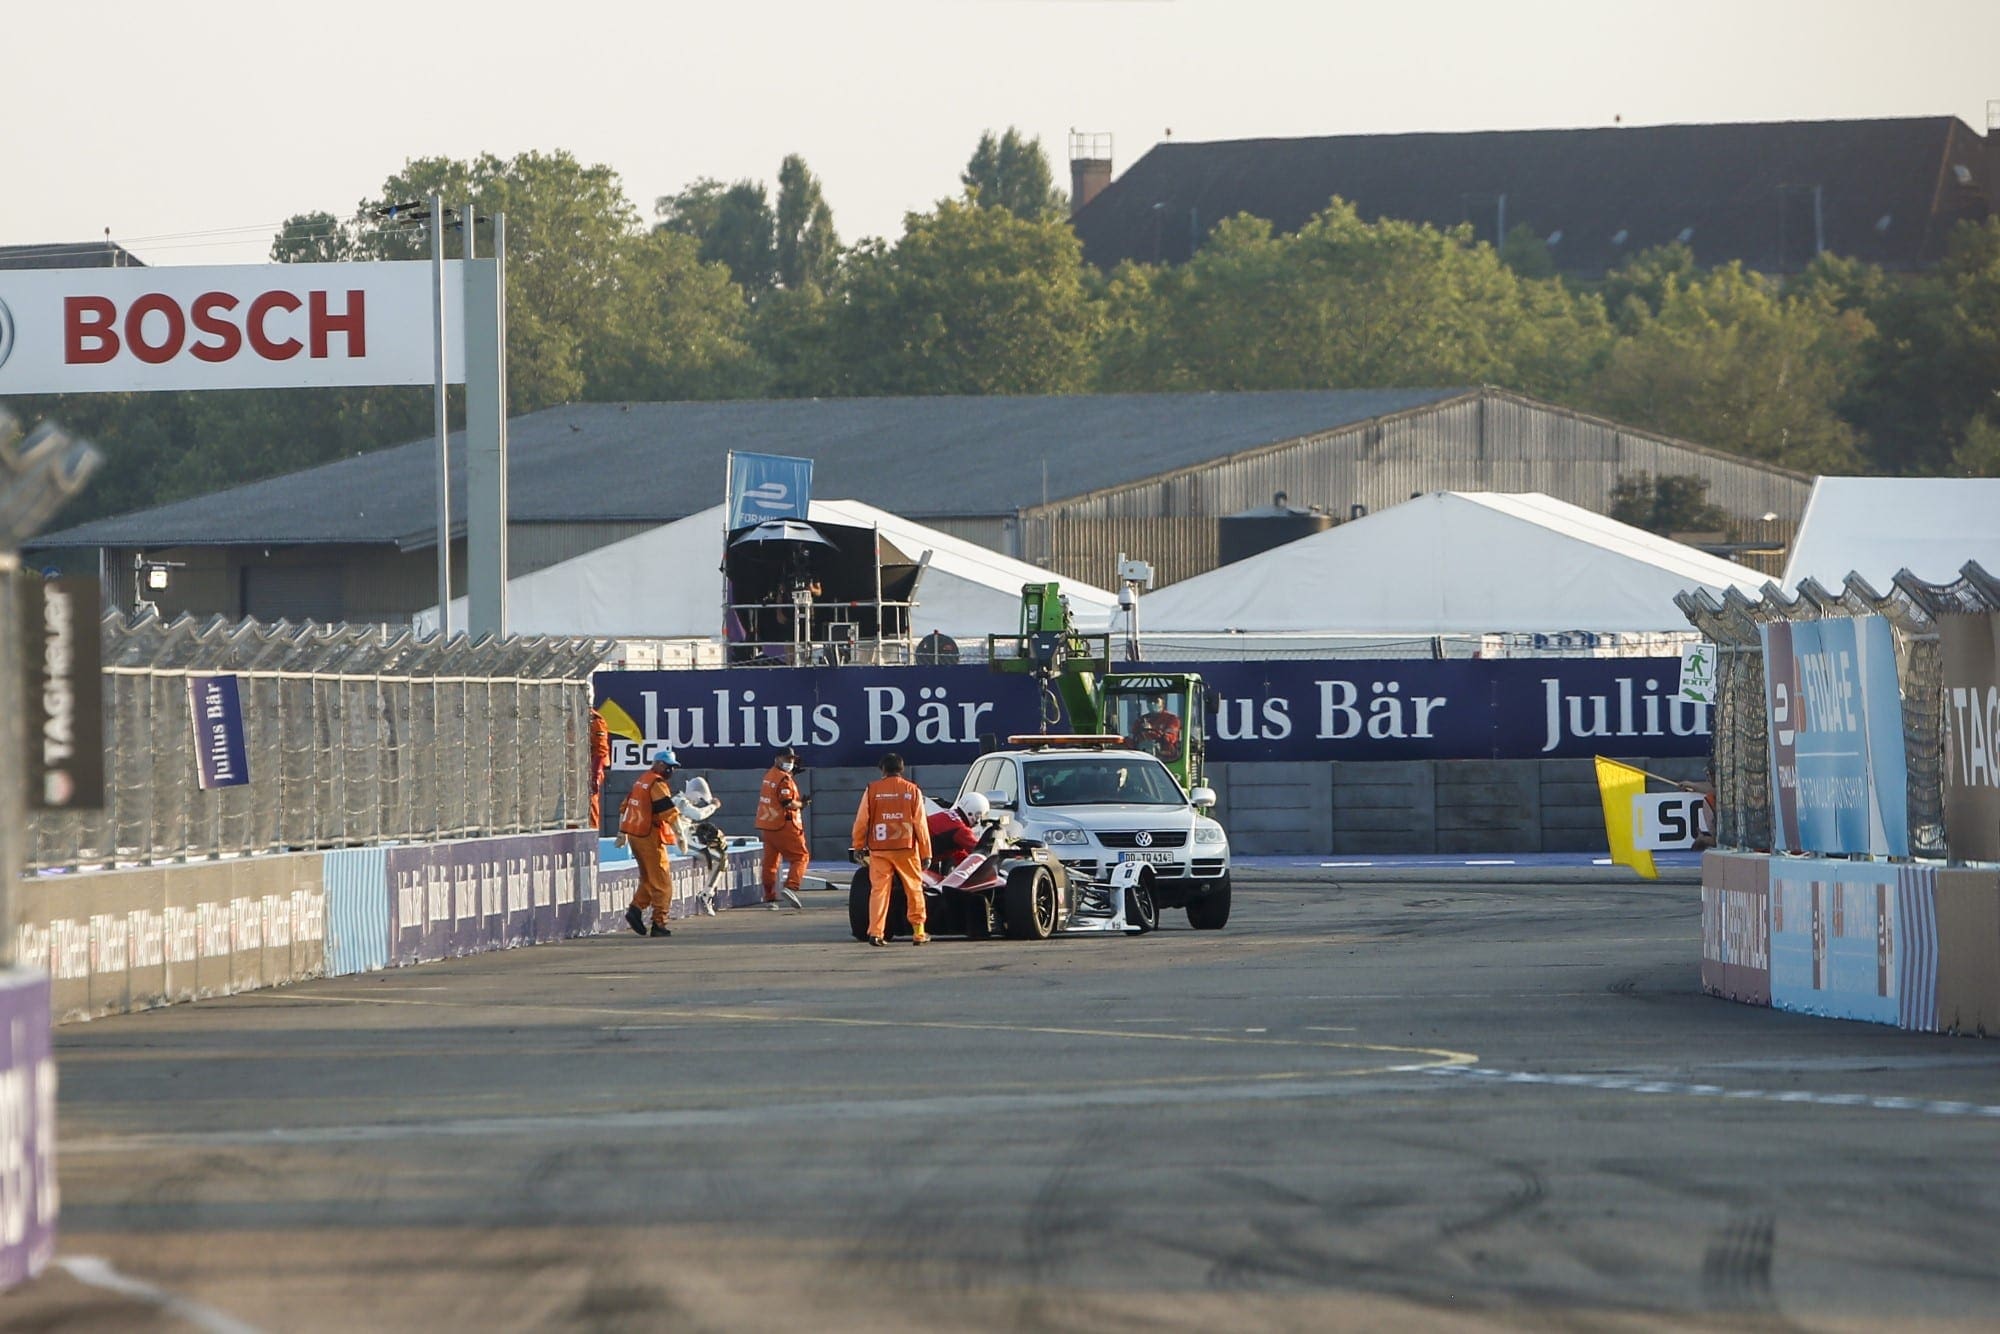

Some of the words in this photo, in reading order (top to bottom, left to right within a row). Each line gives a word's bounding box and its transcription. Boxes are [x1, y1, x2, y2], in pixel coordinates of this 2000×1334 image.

[64, 290, 366, 364] BOSCH
[206, 683, 224, 719] Bär
[640, 690, 840, 748] Julius
[863, 686, 993, 745] Bär
[1314, 680, 1447, 740] Bär
[211, 724, 235, 781] Julius
[625, 743, 658, 766] SC
[875, 823, 887, 841] 8
